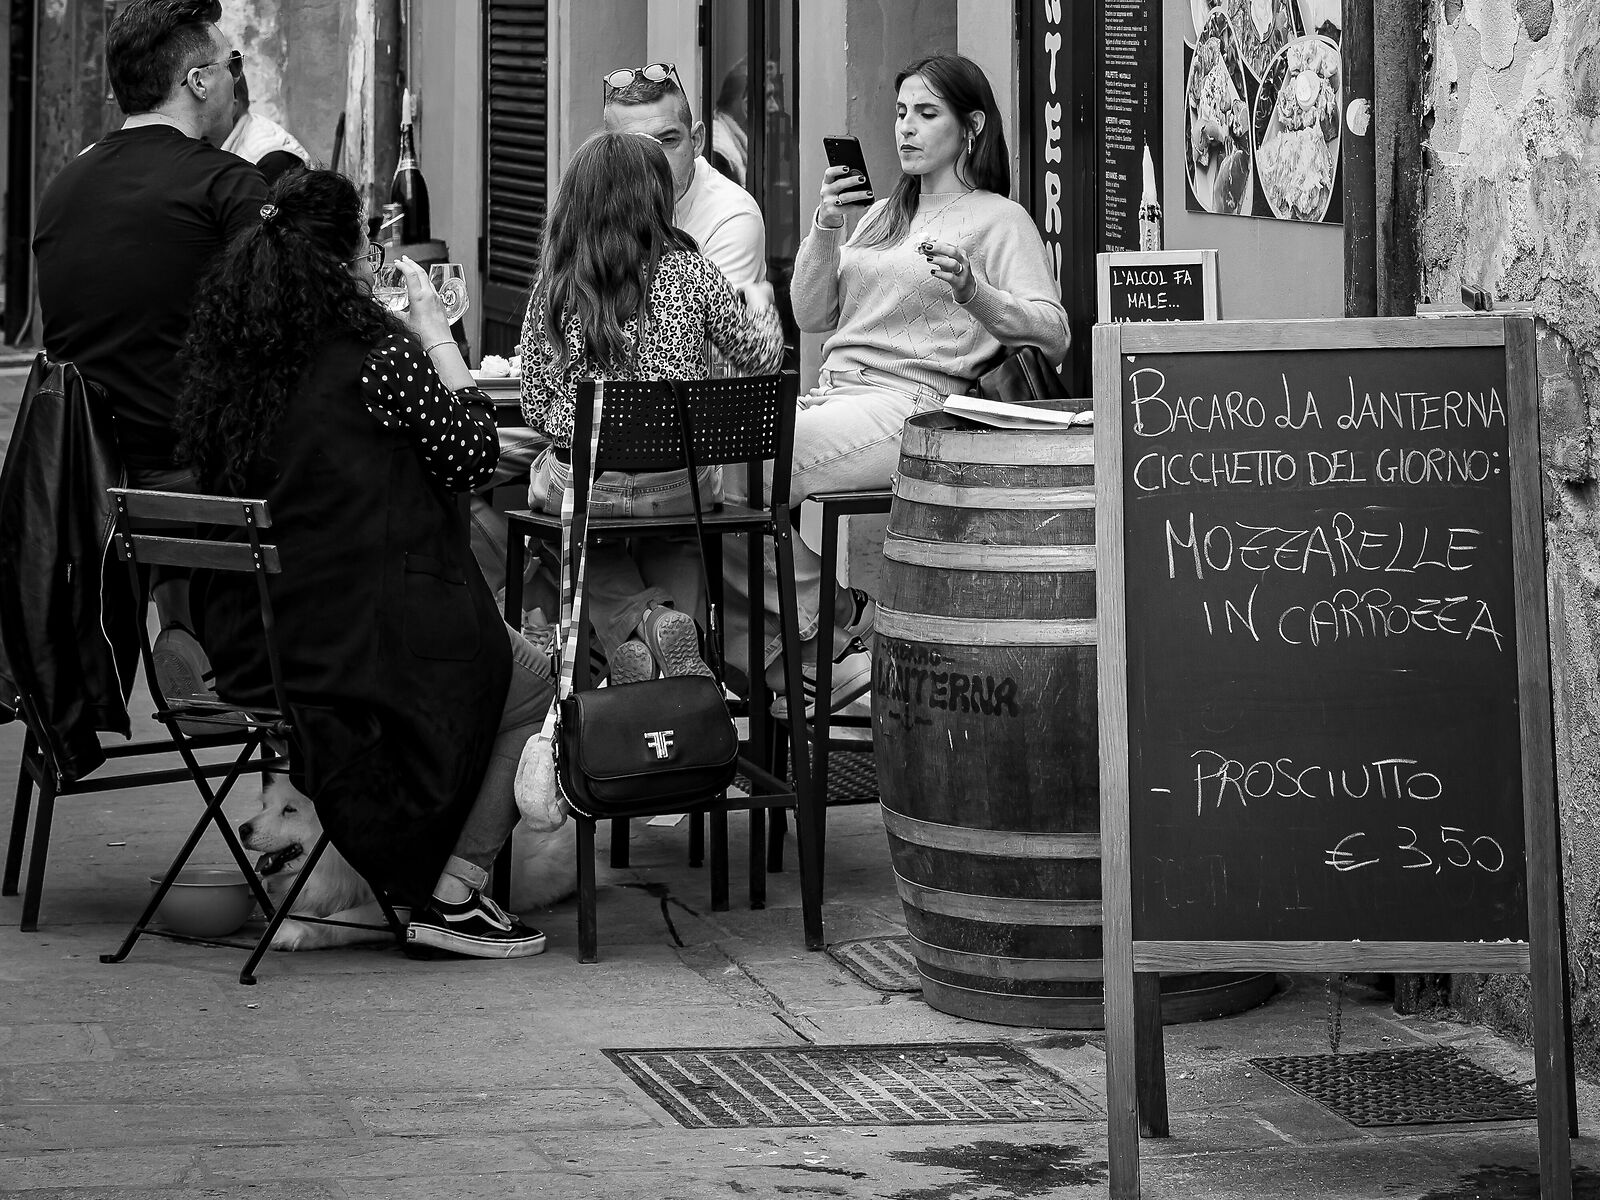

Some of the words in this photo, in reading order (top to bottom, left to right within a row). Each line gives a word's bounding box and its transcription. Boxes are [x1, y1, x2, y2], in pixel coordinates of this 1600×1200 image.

[1113, 270, 1168, 286] L'ALCOL
[1173, 269, 1193, 286] FA
[1129, 368, 1266, 437] BACARO
[1275, 372, 1323, 429] LA
[1337, 375, 1507, 431] LANTERNA
[1133, 450, 1296, 491] CICCHETTO
[1308, 449, 1367, 487] DEL
[1376, 447, 1501, 485] GIORNO:
[1165, 511, 1485, 580] MOZZARELLE
[1203, 583, 1260, 642] IN
[1278, 588, 1504, 652] CARROZZA
[1190, 749, 1443, 817] PROSCIUTTO
[1397, 825, 1505, 874] 3,50
